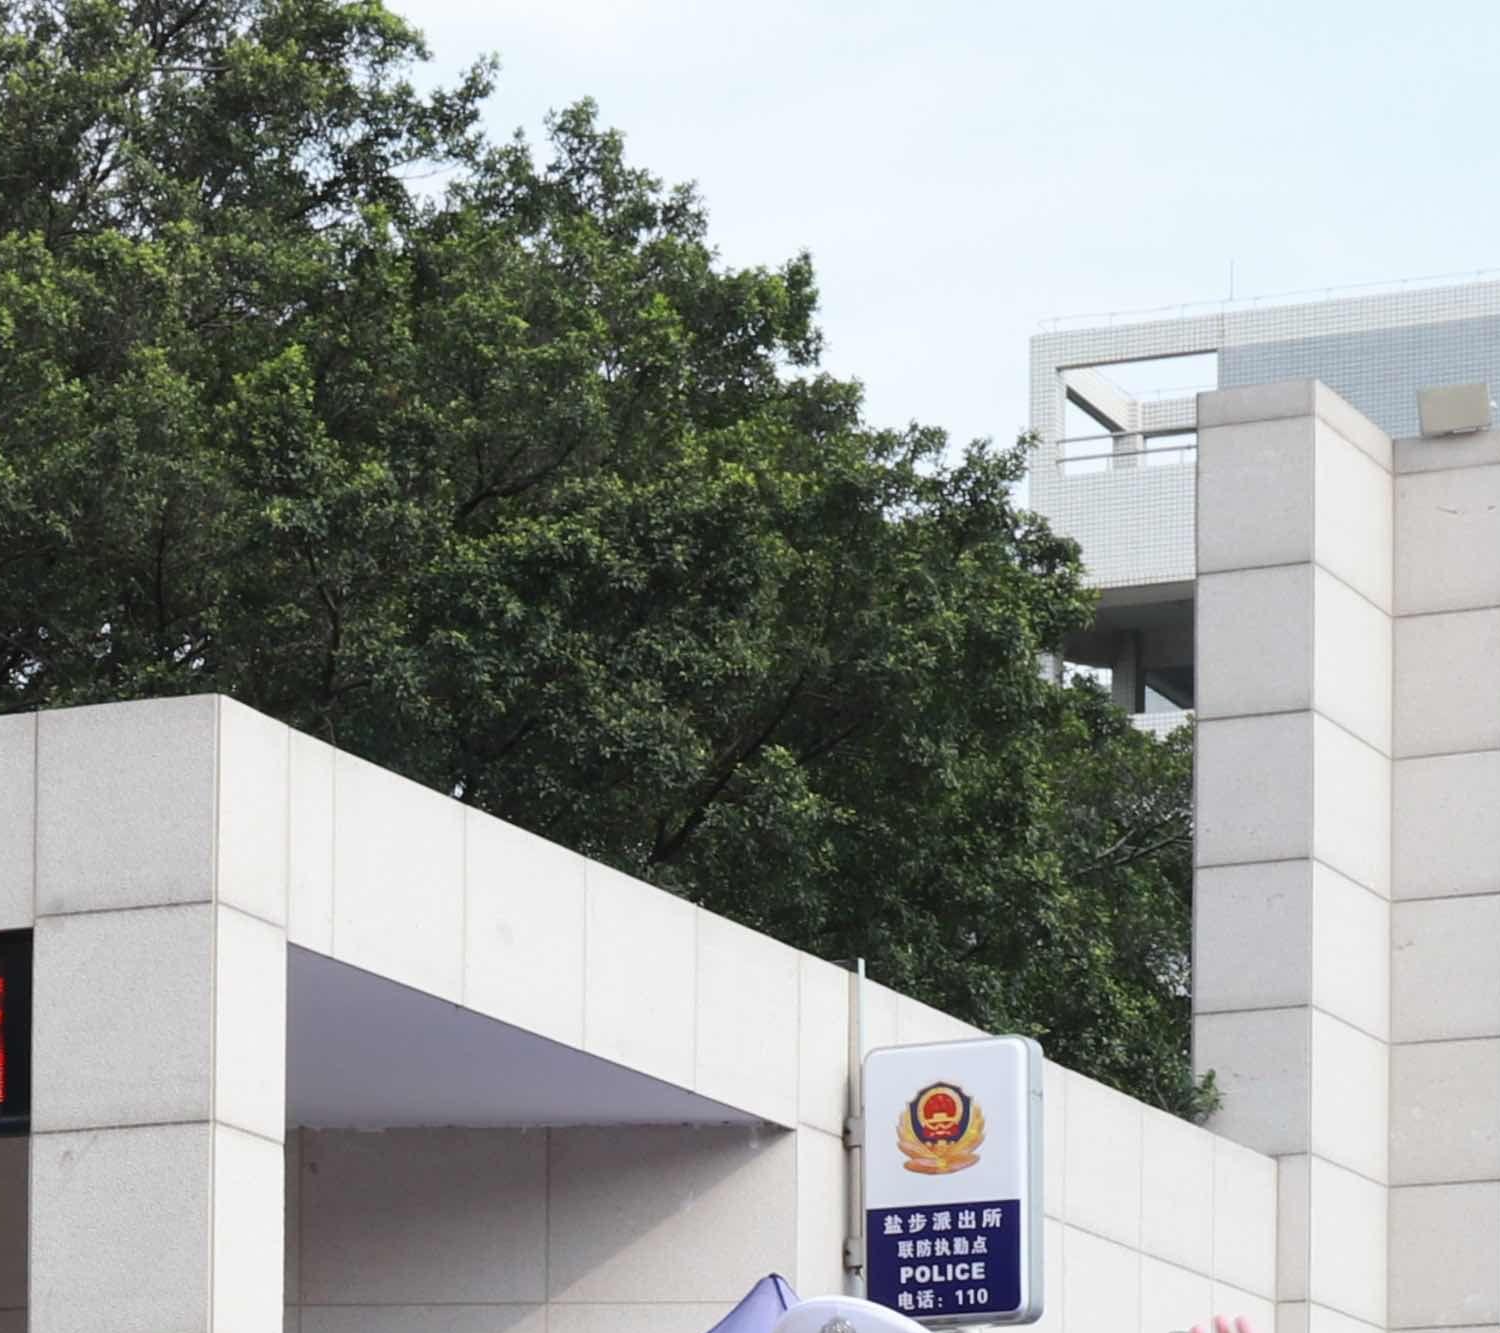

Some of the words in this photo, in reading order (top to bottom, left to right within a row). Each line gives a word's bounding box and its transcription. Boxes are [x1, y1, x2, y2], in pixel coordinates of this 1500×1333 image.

[883, 1208, 1002, 1235] 盐步派出所
[897, 1236, 988, 1258] 联防执勤点
[900, 1262, 986, 1284] POLICE
